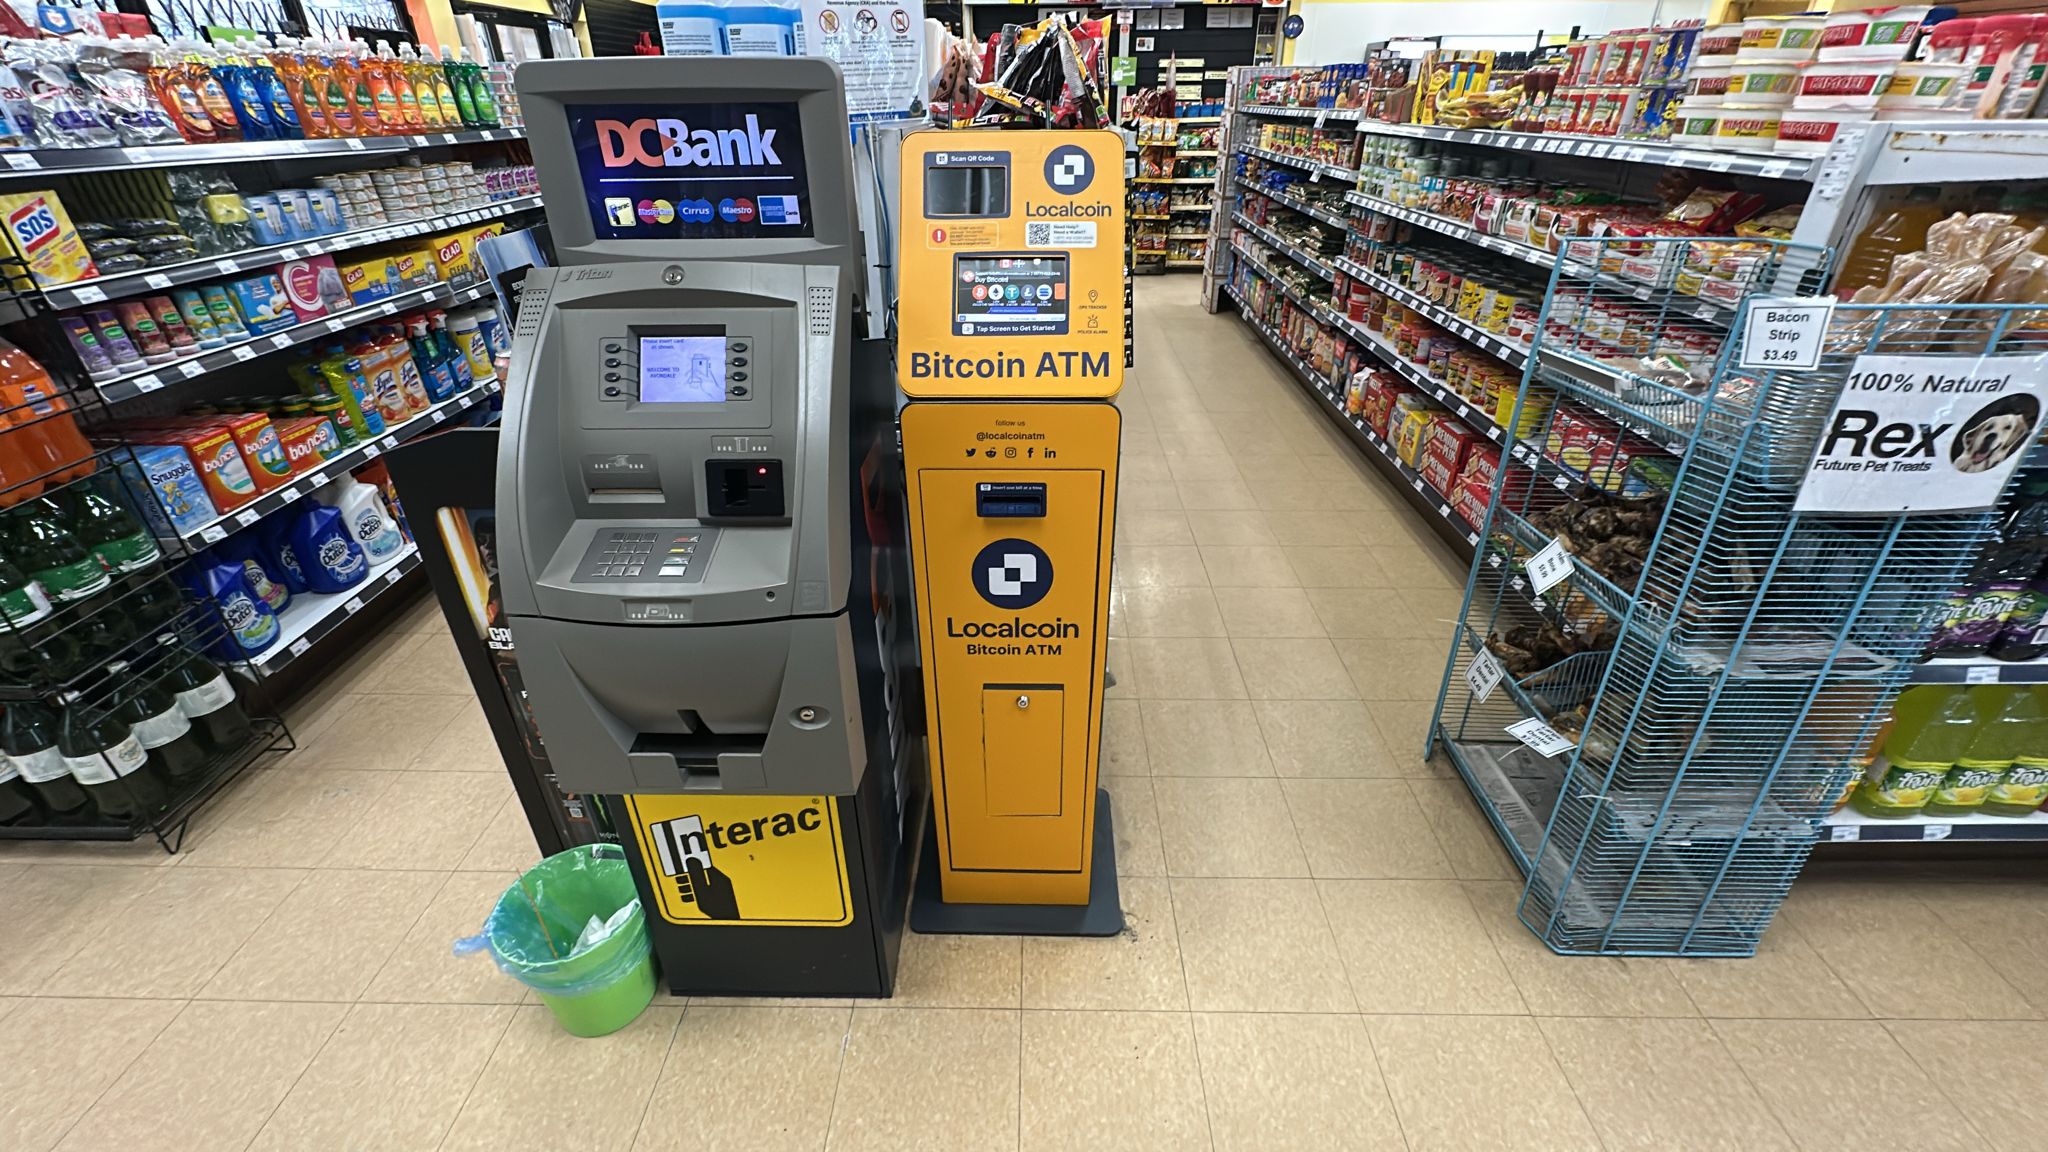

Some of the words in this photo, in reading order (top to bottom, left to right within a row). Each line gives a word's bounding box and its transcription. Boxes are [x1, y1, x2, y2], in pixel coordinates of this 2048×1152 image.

[595, 113, 782, 167] DCBank
[682, 207, 710, 215] Cirrus
[1026, 201, 1112, 217] Localcoin
[16, 209, 54, 242] SOS
[440, 242, 460, 262] GLAD
[400, 258, 413, 272] GLAD
[346, 269, 364, 283] GLAD
[1766, 312, 1810, 322] Bacon
[1768, 330, 1801, 343] Strip
[911, 352, 1025, 378] Bitcoin
[1035, 352, 1110, 377] ATM
[1763, 349, 1797, 361] $3.49
[374, 370, 395, 392] Lysol
[1849, 373, 1914, 392] 100%
[1922, 374, 2011, 393] Natural
[244, 431, 275, 455] bounce
[288, 428, 328, 460] bounce
[976, 432, 1045, 441] @localcoinatm
[1820, 409, 1953, 458] Rex
[202, 446, 236, 472] bounce
[1813, 459, 1862, 472] Future
[1864, 460, 1888, 472] Pet
[1891, 460, 1932, 472] Treats
[151, 462, 192, 486] Snuggle
[359, 519, 381, 540] Dutch
[323, 544, 346, 566] Dutch
[226, 604, 253, 628] Dutch
[947, 617, 1079, 638] Localcoin
[967, 644, 1021, 655] Bitcoin
[1025, 644, 1062, 655] ATM
[662, 806, 822, 874] Interac
